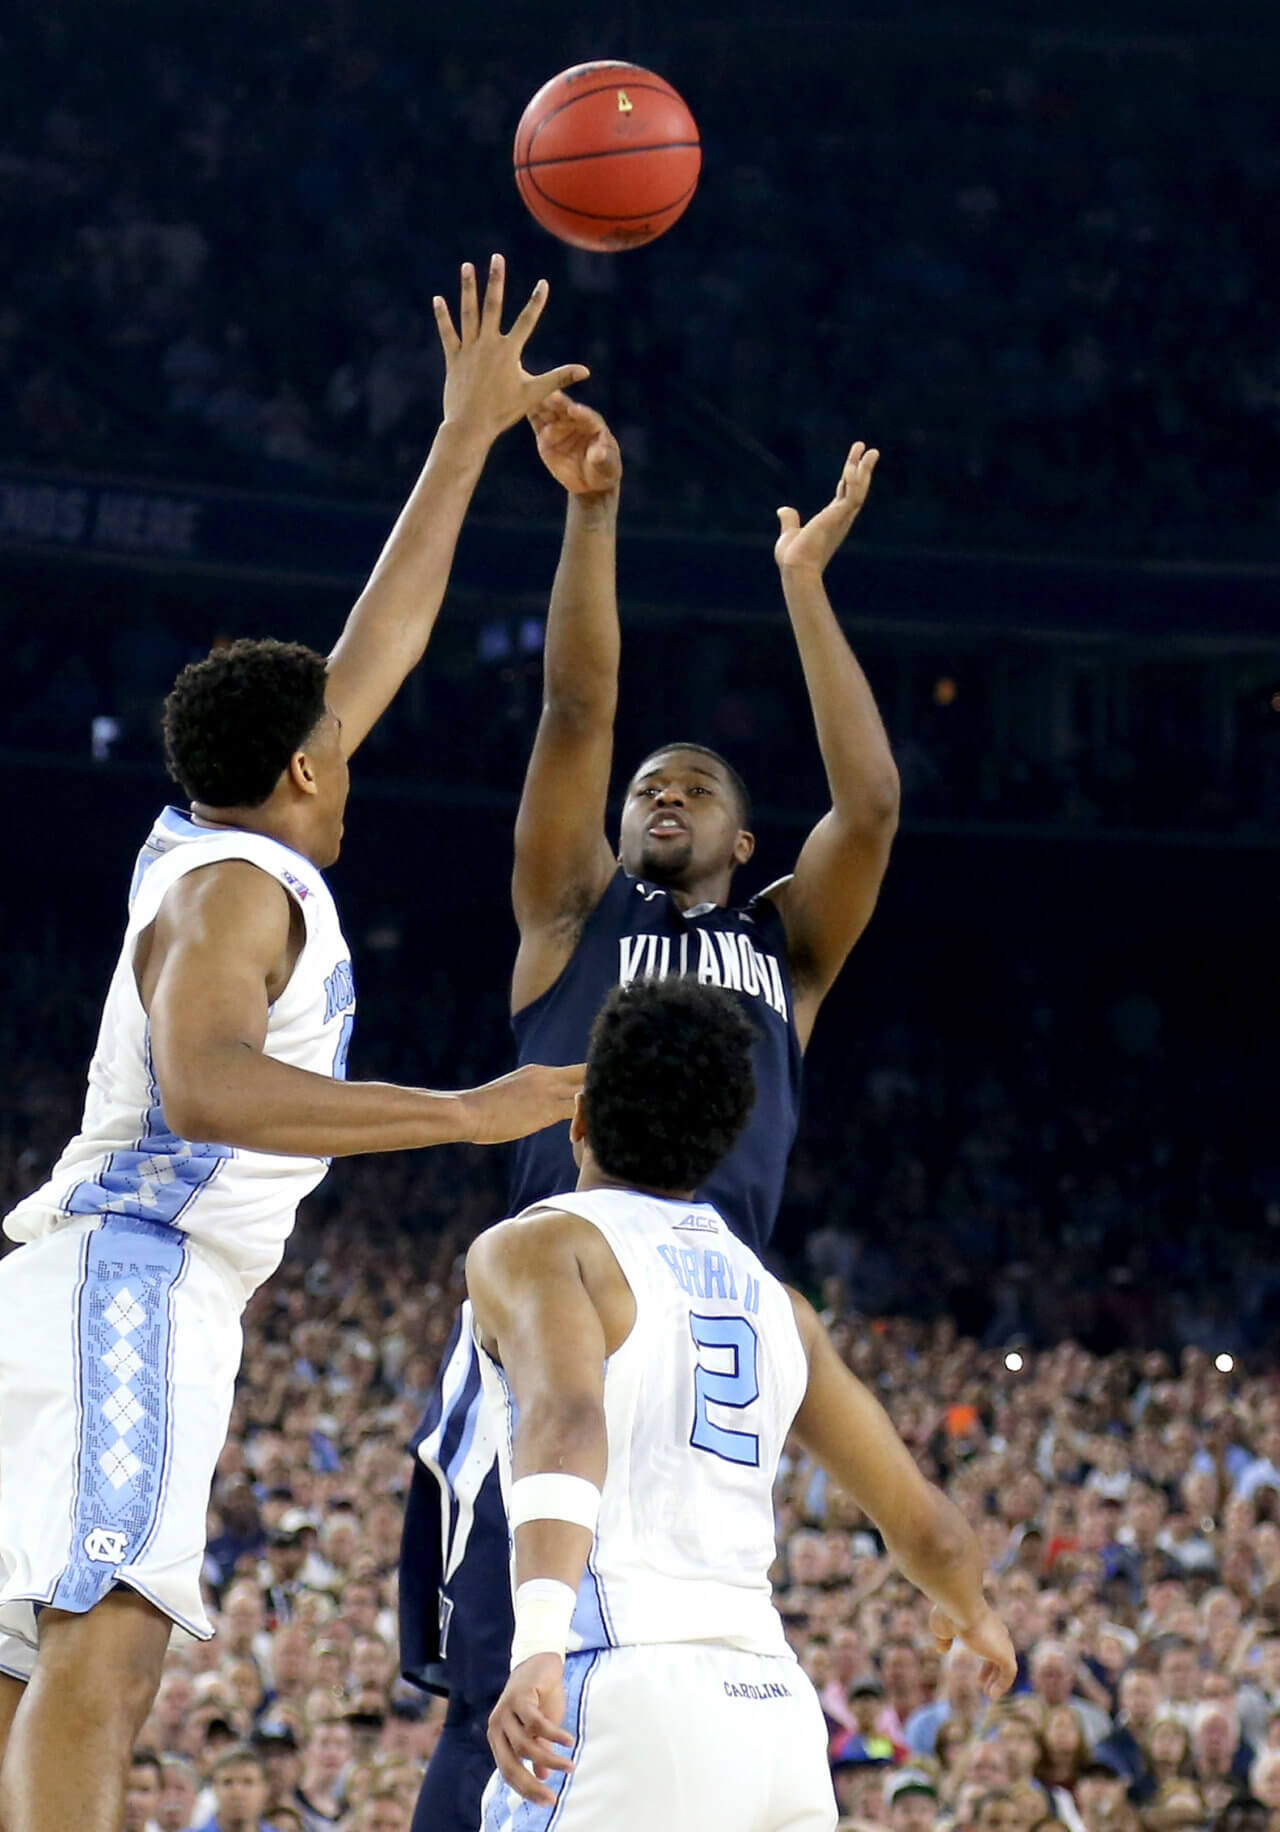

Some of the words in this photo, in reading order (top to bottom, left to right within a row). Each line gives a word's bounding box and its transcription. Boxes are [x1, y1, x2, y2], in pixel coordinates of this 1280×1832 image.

[619, 928, 788, 1023] VILLANOVA
[678, 1214, 719, 1231] ACC
[689, 1310, 760, 1467] 2
[723, 1681, 792, 1700] CAROLINA
